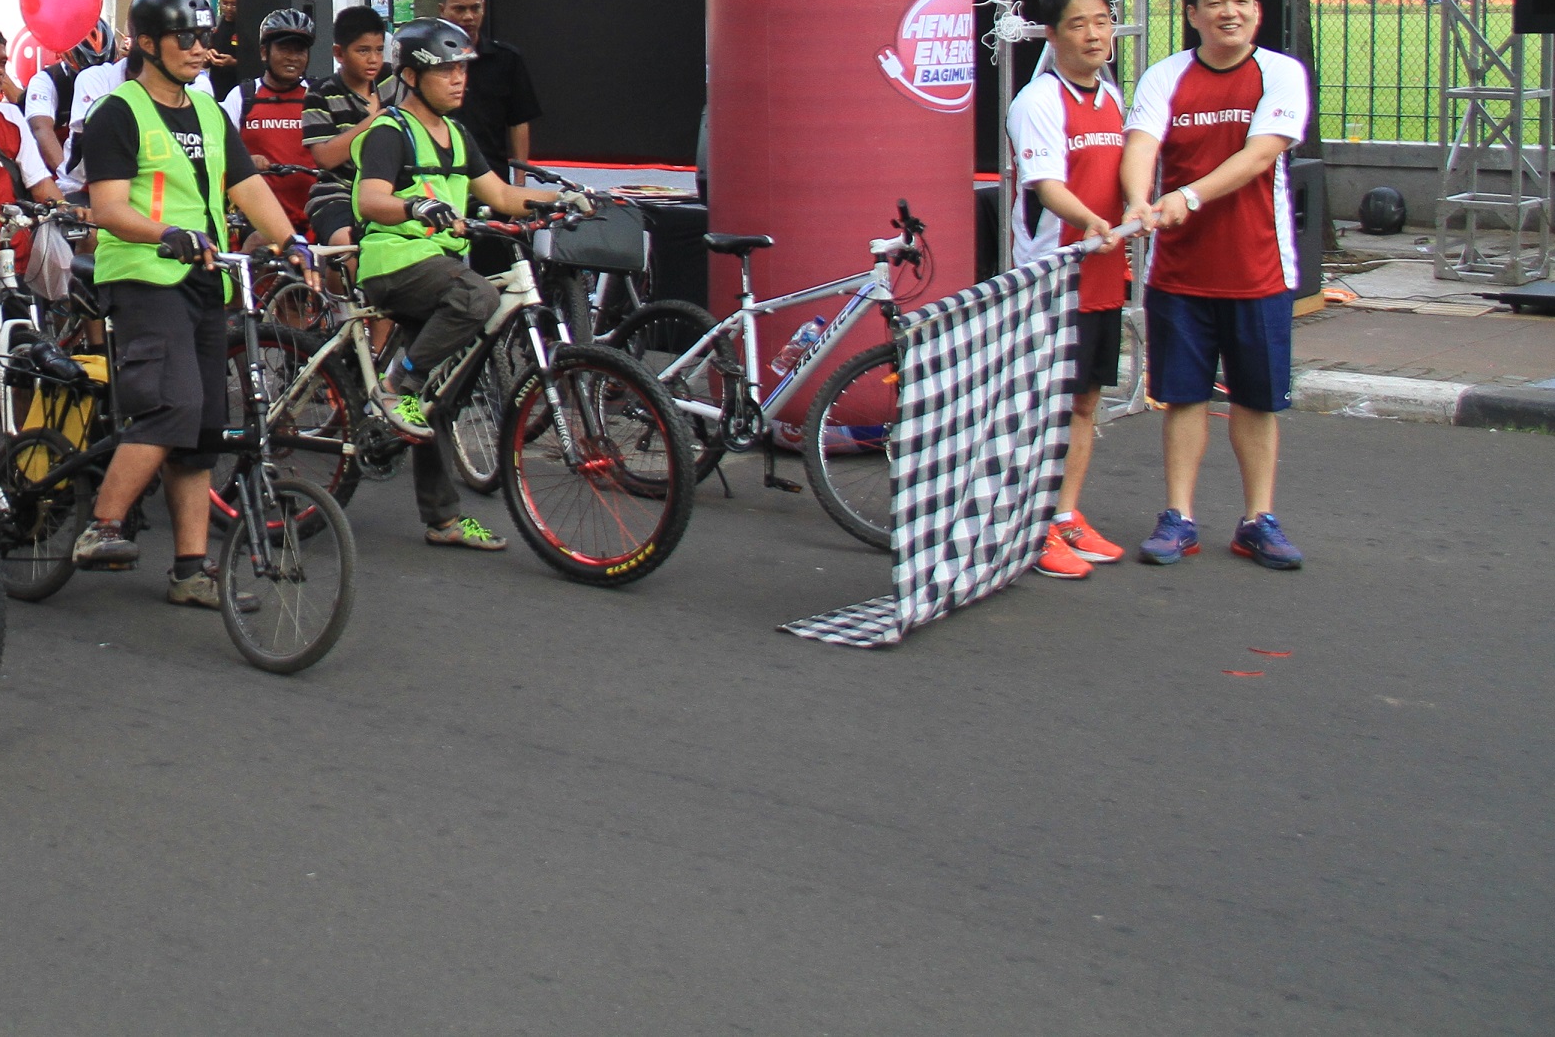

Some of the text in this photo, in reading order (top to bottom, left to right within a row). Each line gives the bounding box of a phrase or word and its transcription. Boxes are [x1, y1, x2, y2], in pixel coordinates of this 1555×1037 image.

[902, 14, 972, 39] HEMAT
[920, 68, 965, 83] BAGIMU
[1173, 109, 1255, 127] LG INVERTE
[1283, 111, 1295, 119] LG
[245, 120, 259, 129] LG
[1068, 135, 1083, 151] LG
[1035, 148, 1048, 157] LG
[793, 309, 848, 377] PACIFIC
